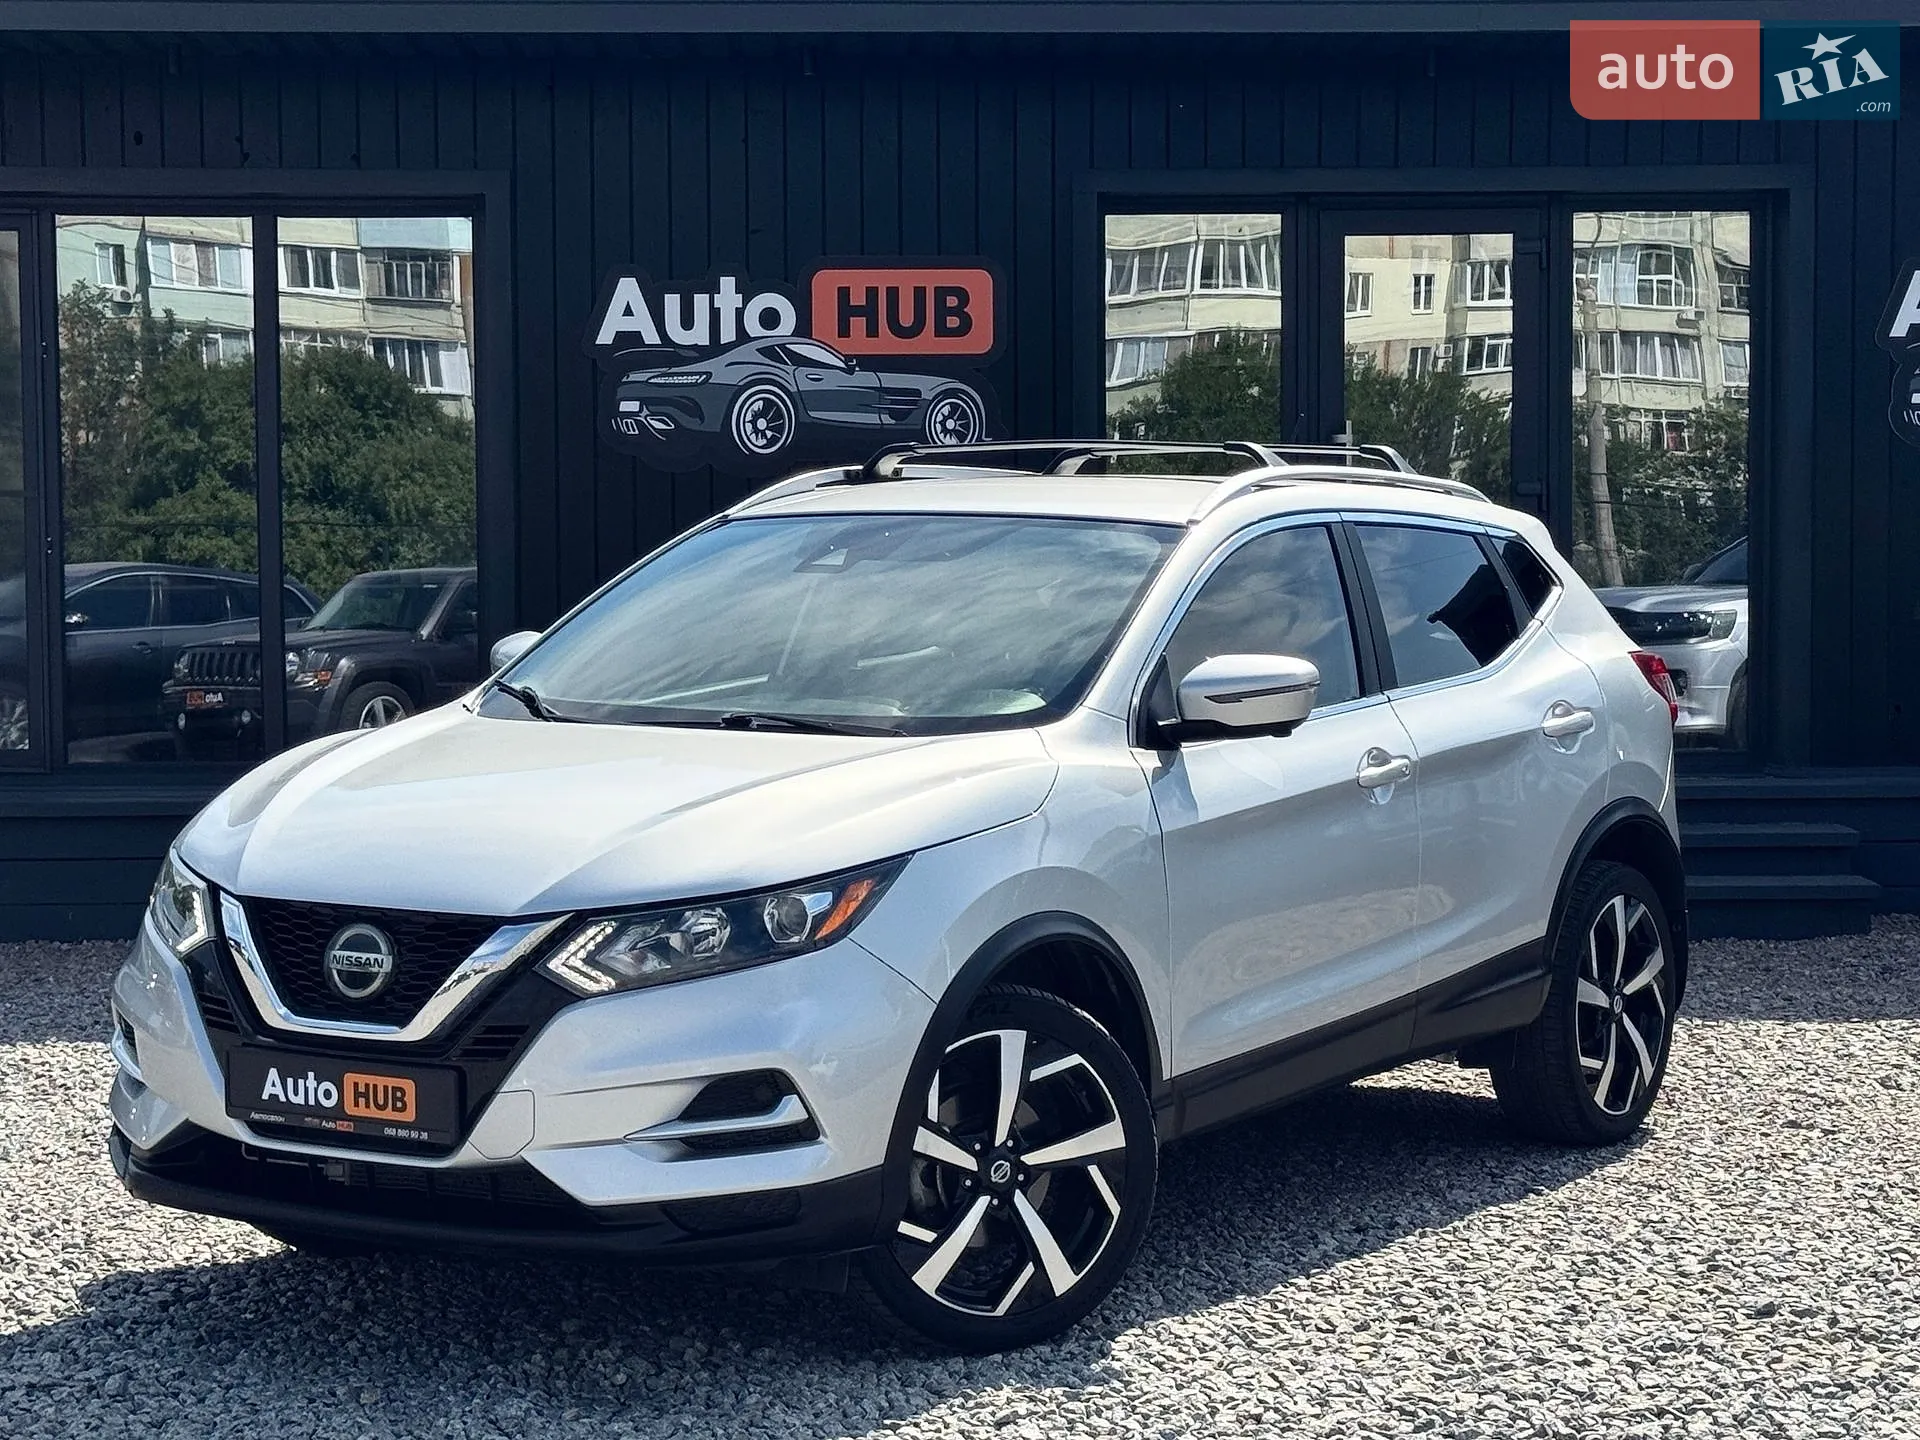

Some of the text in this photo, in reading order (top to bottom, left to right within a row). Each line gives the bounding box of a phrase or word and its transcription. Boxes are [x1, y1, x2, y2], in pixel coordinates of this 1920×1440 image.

[595, 276, 973, 345] Auto HUB
[332, 954, 384, 969] NISSAN
[261, 1067, 408, 1113] Auto HUB
